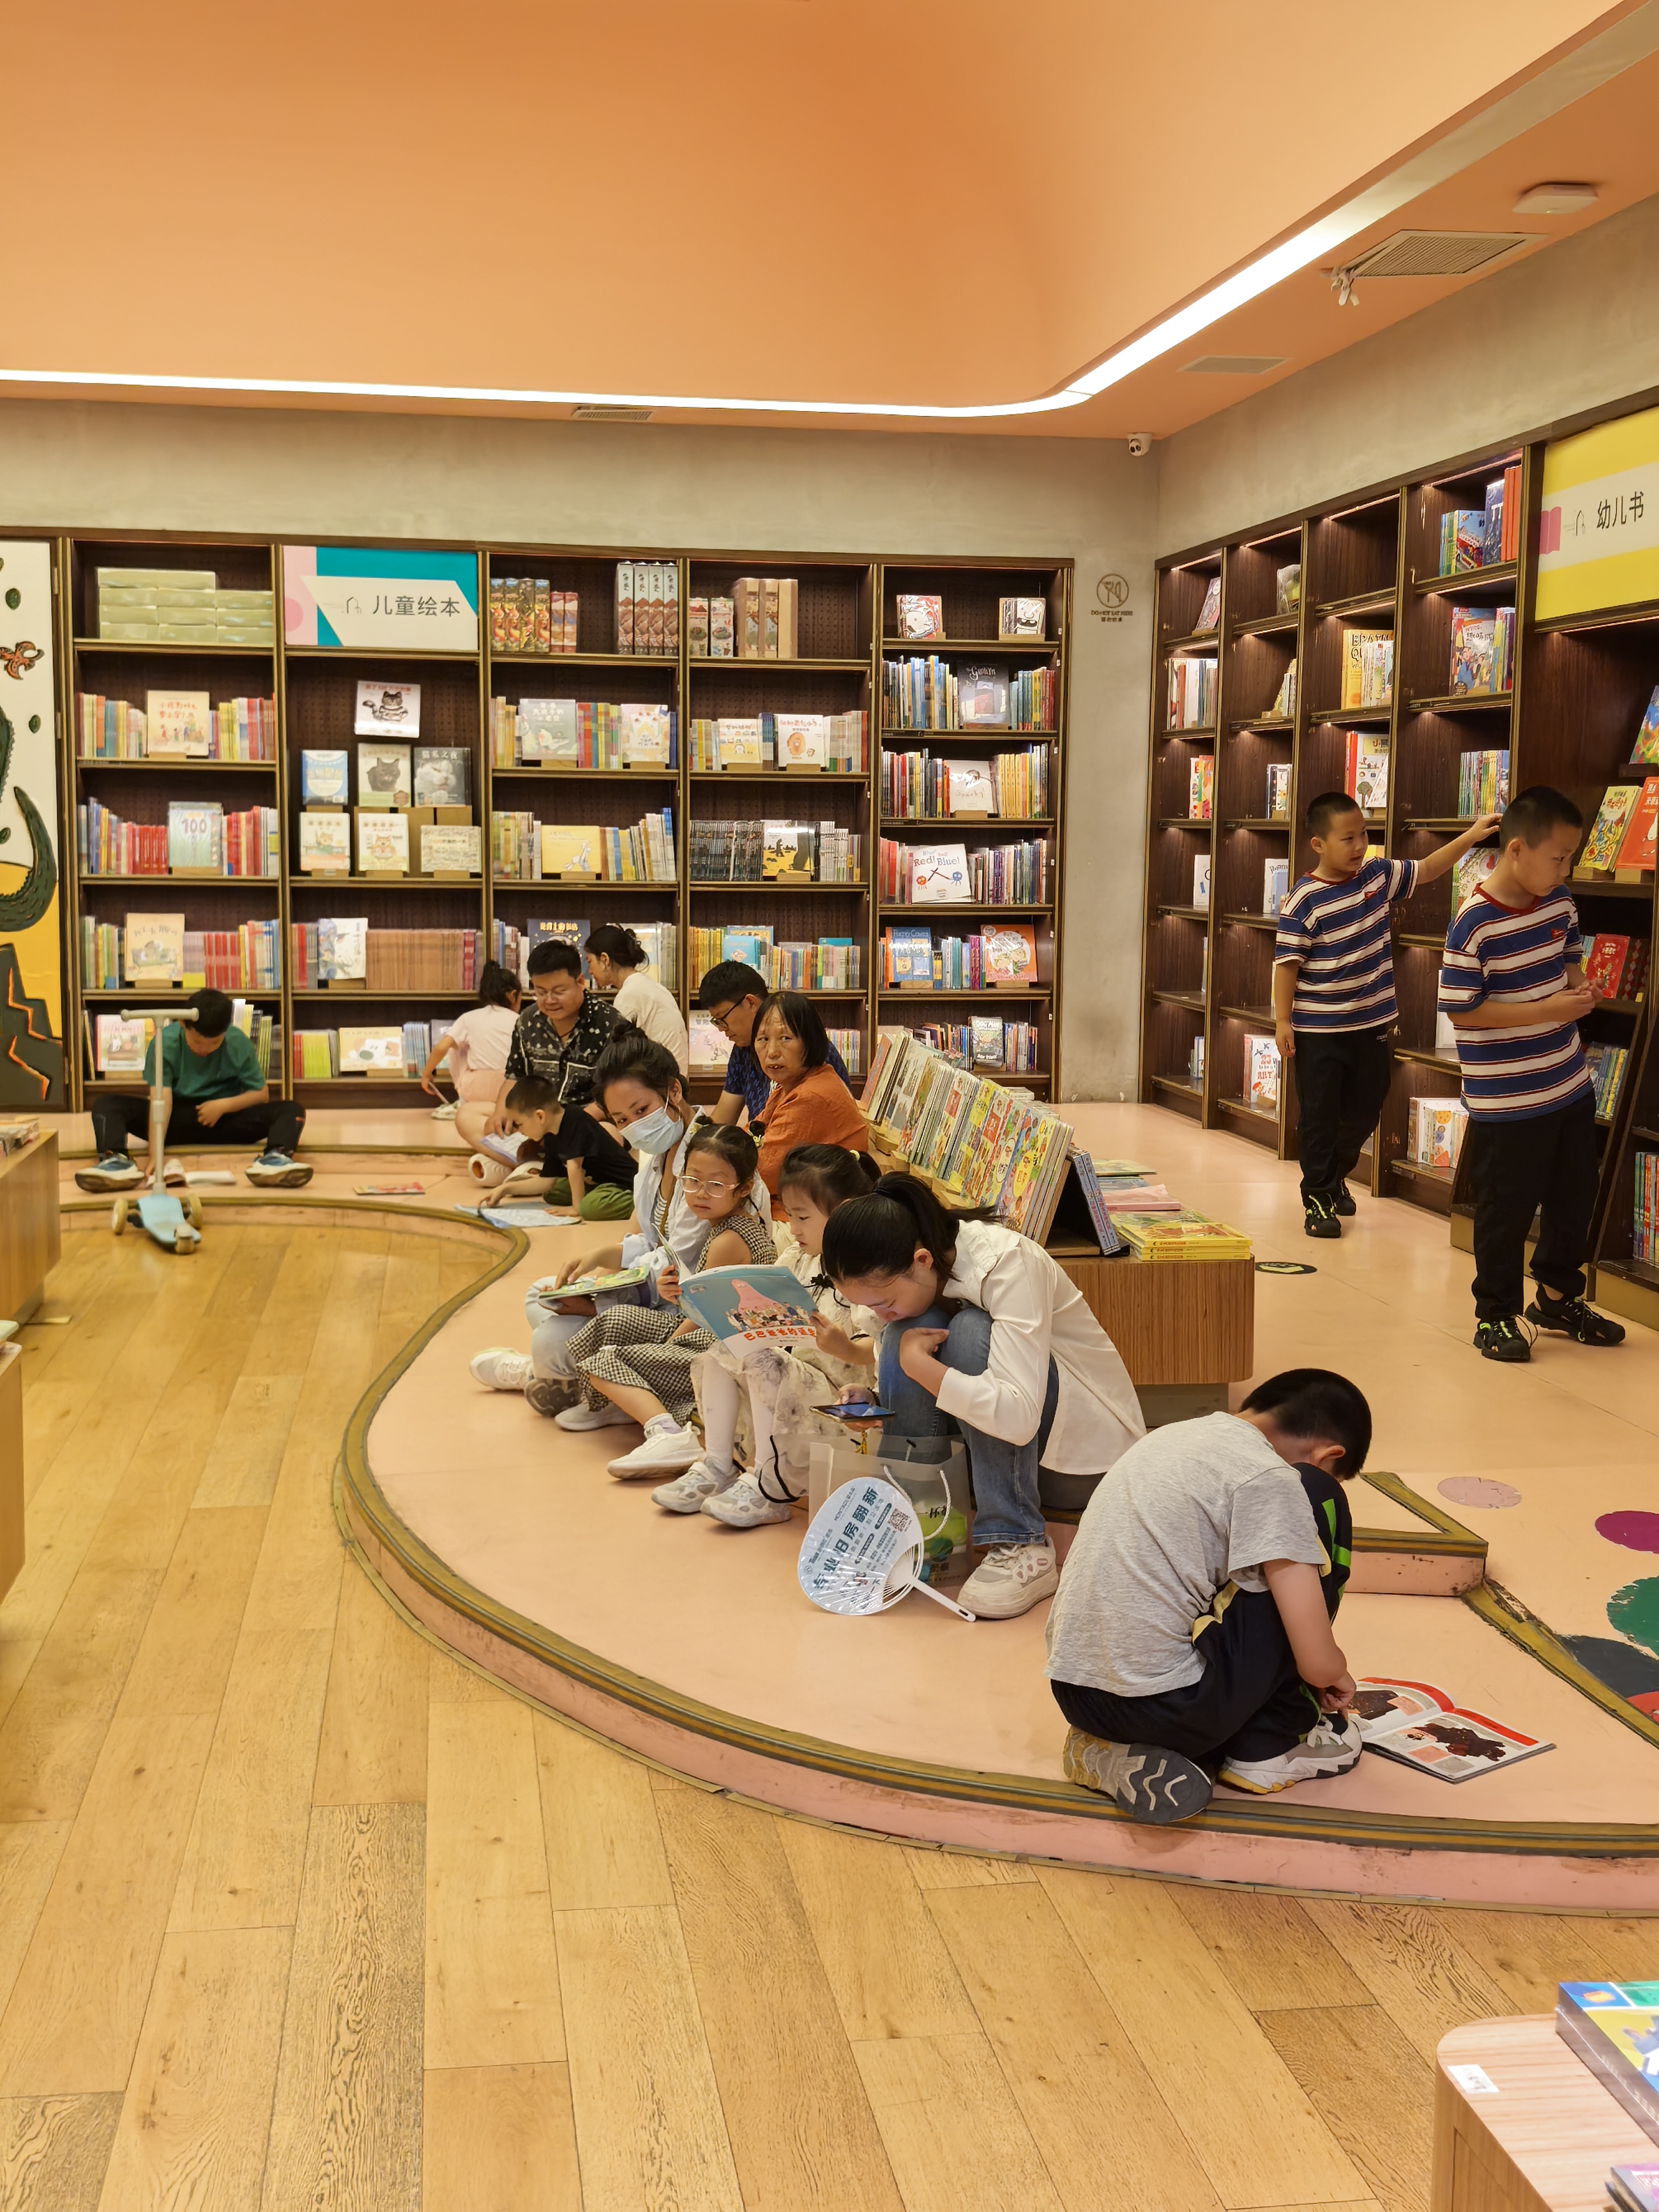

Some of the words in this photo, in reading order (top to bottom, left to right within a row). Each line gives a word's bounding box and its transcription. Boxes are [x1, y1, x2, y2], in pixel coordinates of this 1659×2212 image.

[1596, 490, 1644, 530] 幼儿书
[372, 595, 460, 617] 儿童绘本
[181, 819, 207, 834] 100
[914, 855, 935, 867] Red!
[936, 857, 960, 866] Blue!
[813, 1486, 879, 1589] 专业旧房翻新
